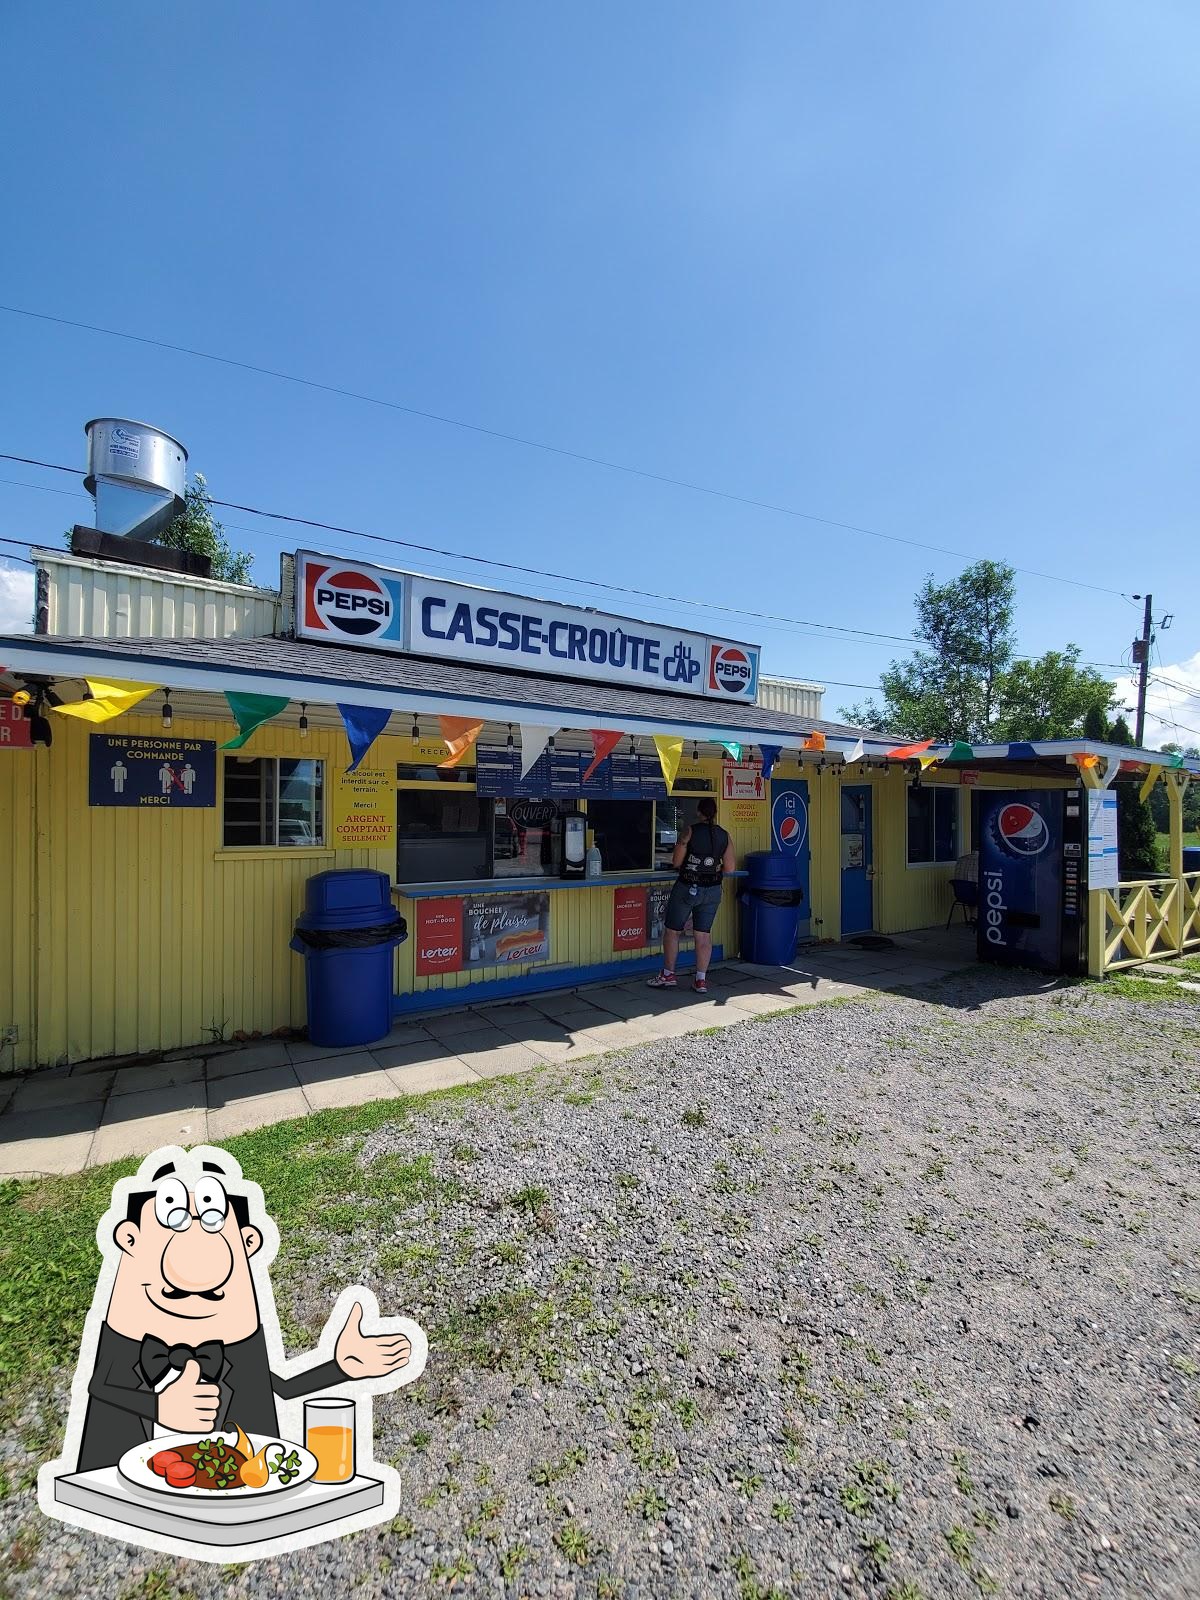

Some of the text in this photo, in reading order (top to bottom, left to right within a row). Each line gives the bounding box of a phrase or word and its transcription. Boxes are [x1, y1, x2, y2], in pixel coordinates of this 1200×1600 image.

[318, 589, 389, 616] PEPSI
[421, 596, 661, 674] CASSE-CROÛTE
[674, 641, 691, 659] du
[663, 657, 700, 683] CAP
[715, 662, 750, 678] PEPSI
[108, 738, 202, 751] UNE PERSONNE PAR
[126, 750, 185, 760] COMMANDE
[341, 777, 367, 785] interdit
[139, 796, 171, 804] MERCI
[785, 797, 796, 808] ici
[345, 815, 386, 823] ARGENT
[514, 805, 553, 820] OUVERT
[336, 825, 393, 833] COMPTANT
[984, 871, 1007, 945] pepsi
[474, 911, 529, 934] de plaisir
